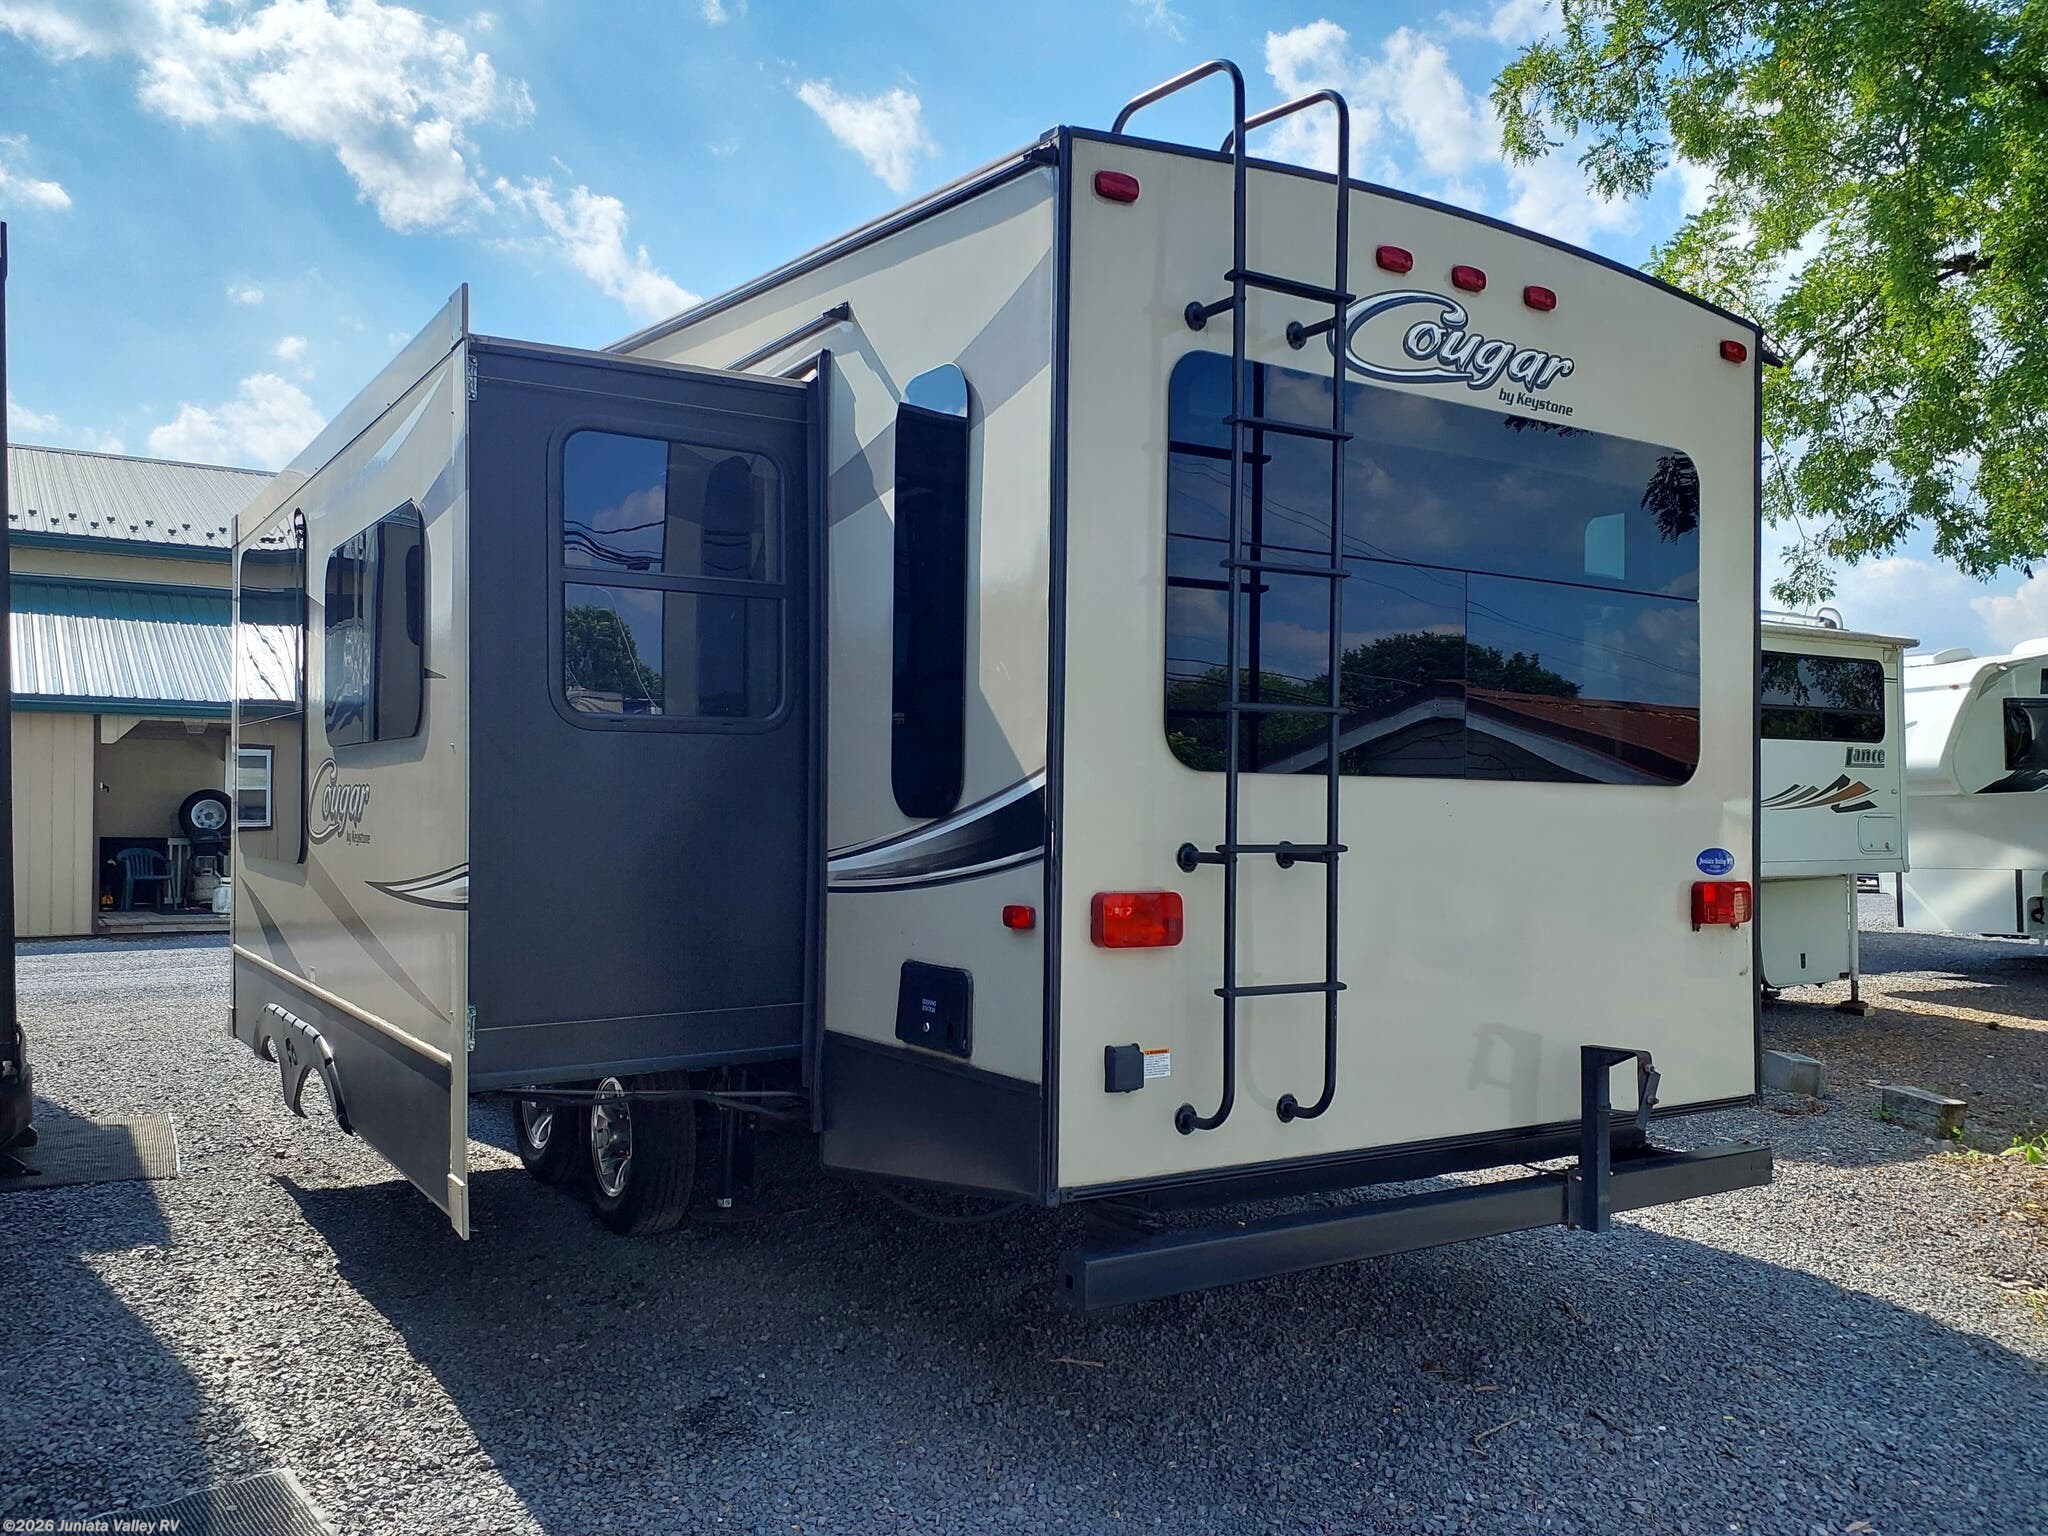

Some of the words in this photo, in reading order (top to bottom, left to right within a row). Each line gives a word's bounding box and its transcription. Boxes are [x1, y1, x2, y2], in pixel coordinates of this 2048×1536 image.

[1327, 290, 1575, 393] Cougar
[1499, 387, 1515, 406] by
[1516, 392, 1573, 417] Keystone
[1845, 747, 1885, 768] Lance
[308, 758, 370, 845] Cougar
